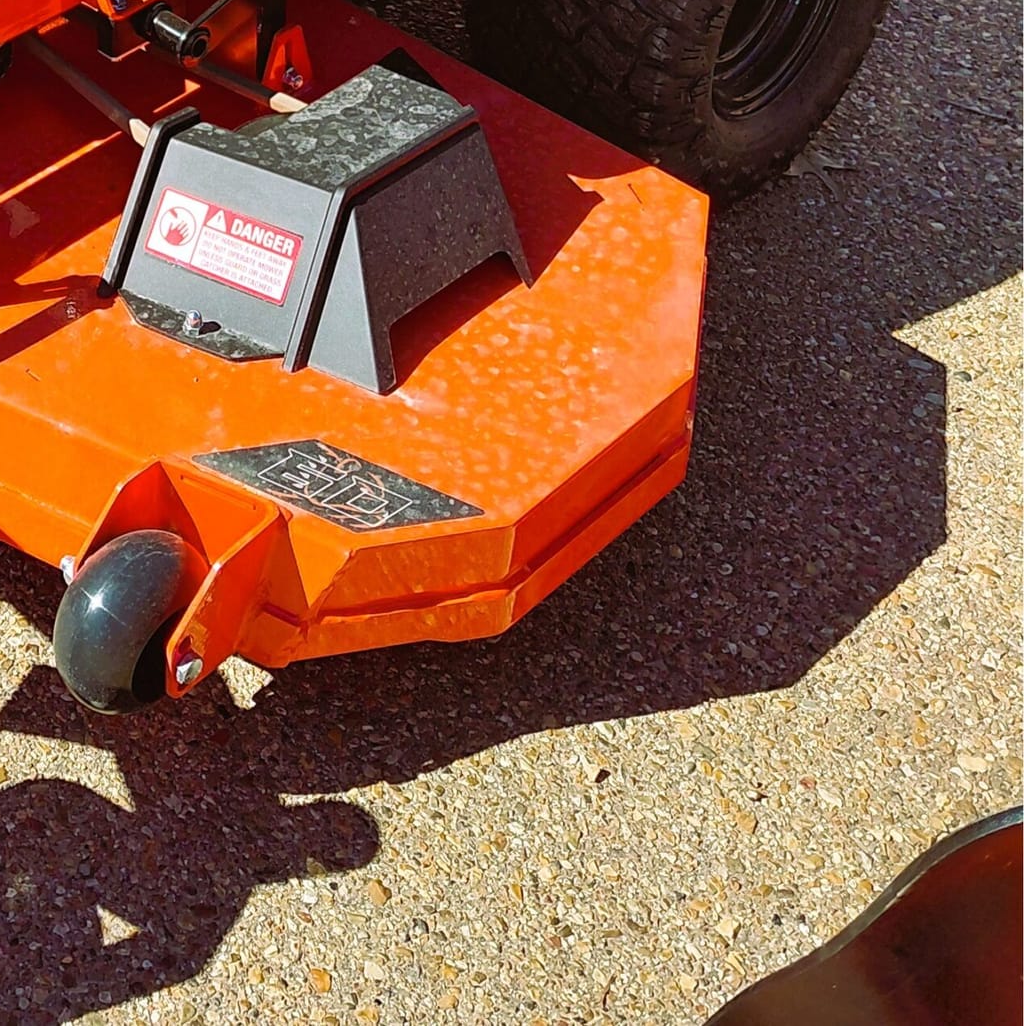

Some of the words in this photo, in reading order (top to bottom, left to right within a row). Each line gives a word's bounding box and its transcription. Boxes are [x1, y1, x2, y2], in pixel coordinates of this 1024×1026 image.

[229, 217, 296, 257] DANGER
[227, 249, 256, 267] OPERATE
[257, 261, 283, 277] MOWER
[238, 274, 273, 293] ATTACHED
